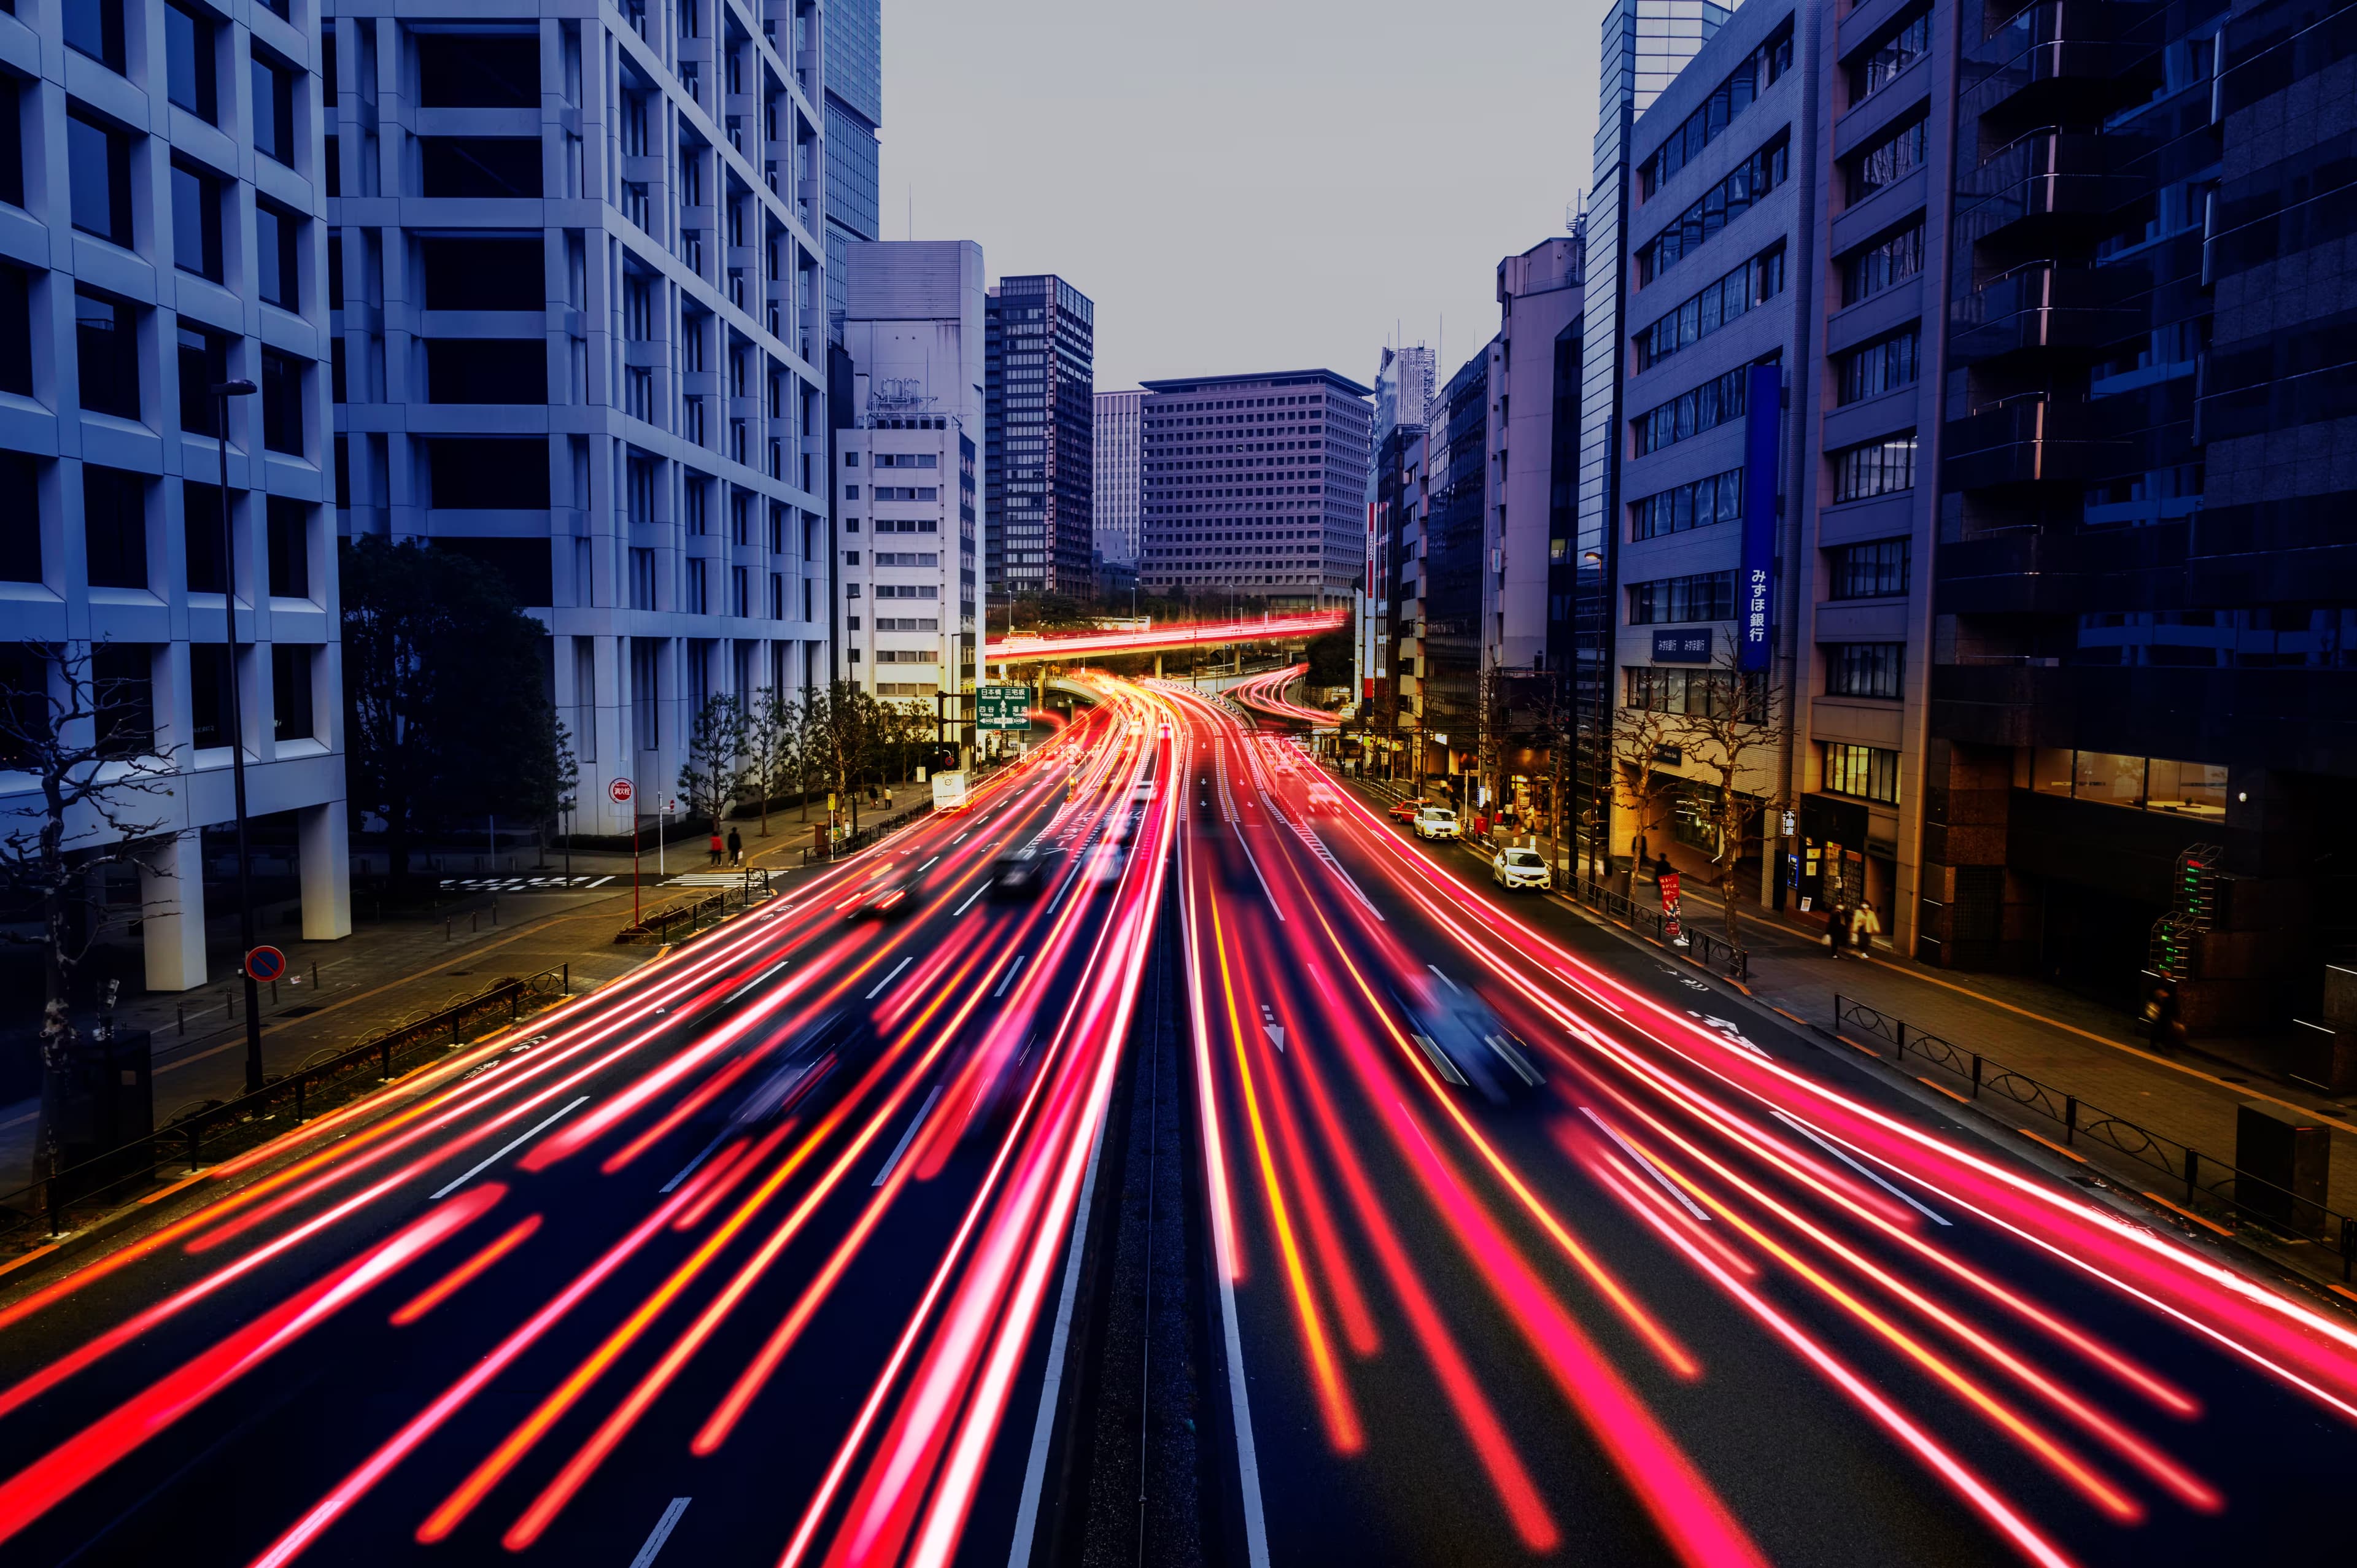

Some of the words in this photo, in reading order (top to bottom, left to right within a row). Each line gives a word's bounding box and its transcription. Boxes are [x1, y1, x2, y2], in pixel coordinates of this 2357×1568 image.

[1749, 570, 1767, 643] みずほ銀行
[1684, 639, 1705, 652] みずほ銀行
[614, 787, 630, 795] 消火栓
